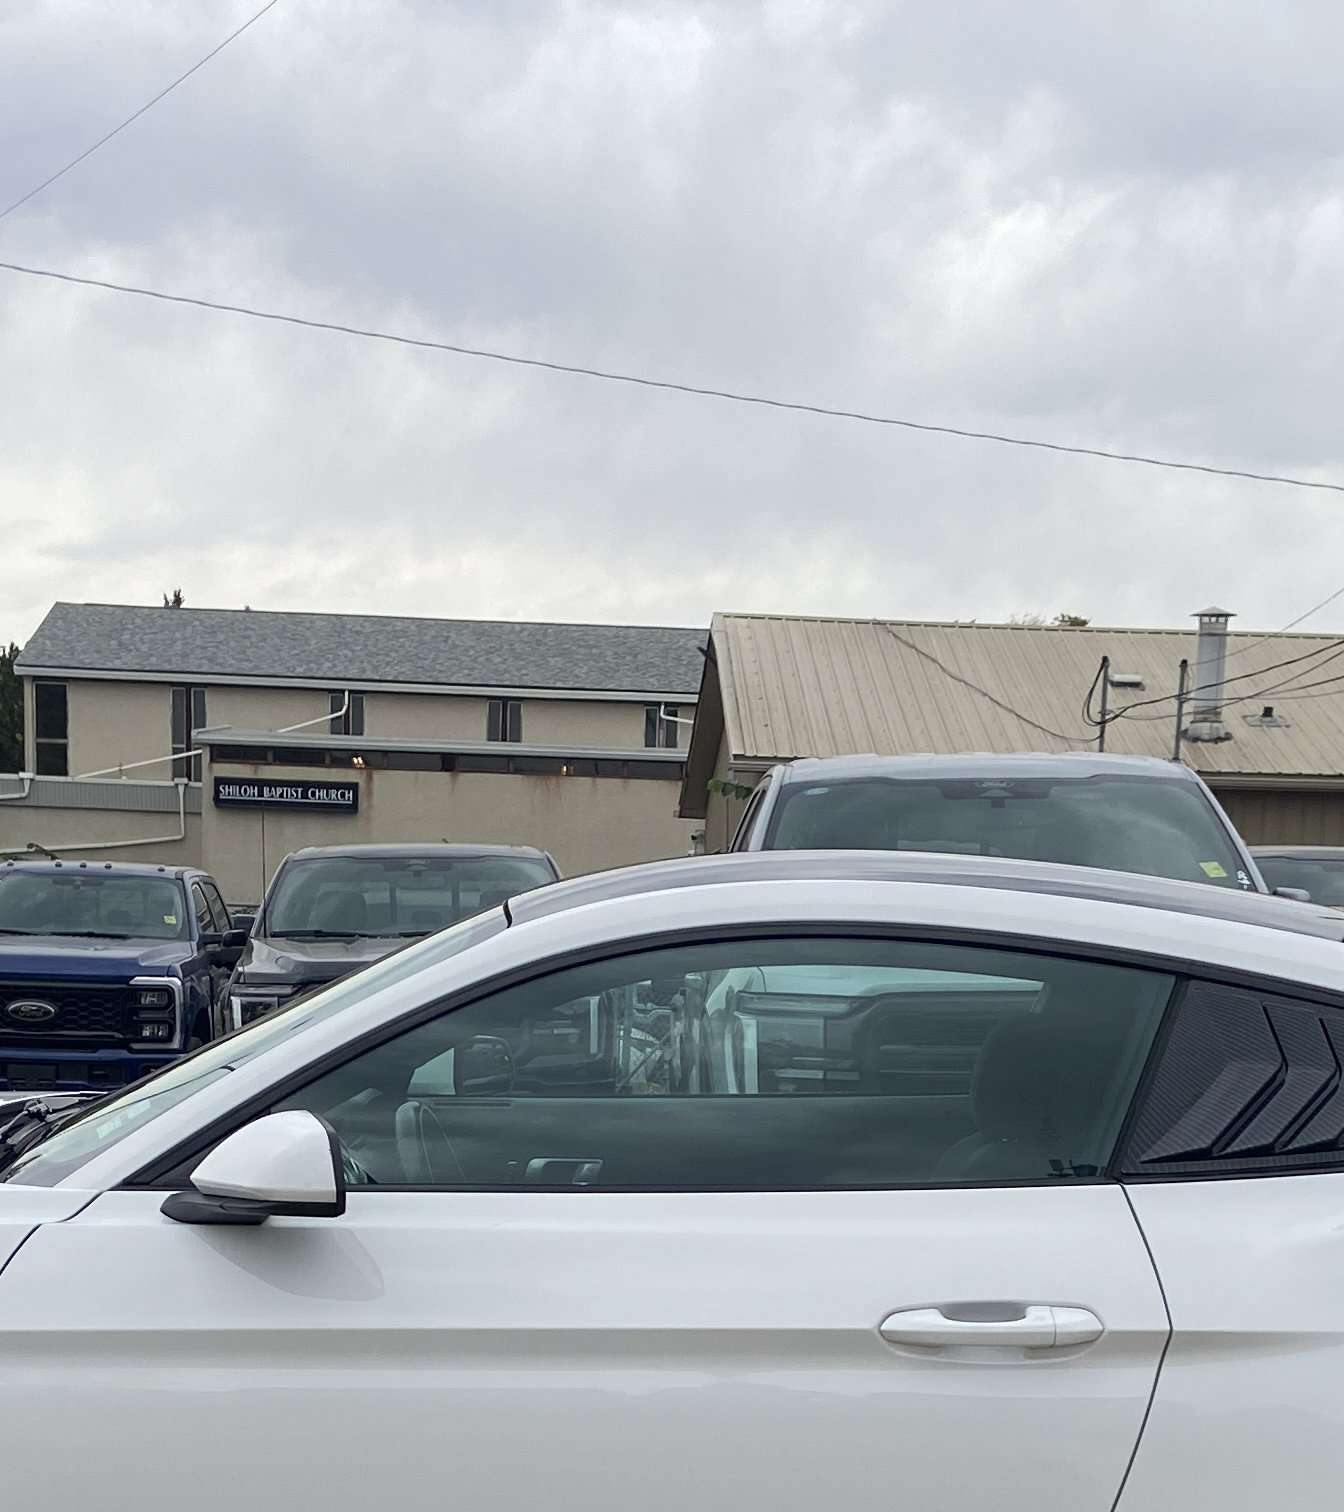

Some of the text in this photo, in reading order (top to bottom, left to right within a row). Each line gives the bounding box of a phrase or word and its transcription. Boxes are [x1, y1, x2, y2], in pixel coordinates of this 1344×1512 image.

[219, 784, 353, 801] SHILOH BAPTIST CHURCH
